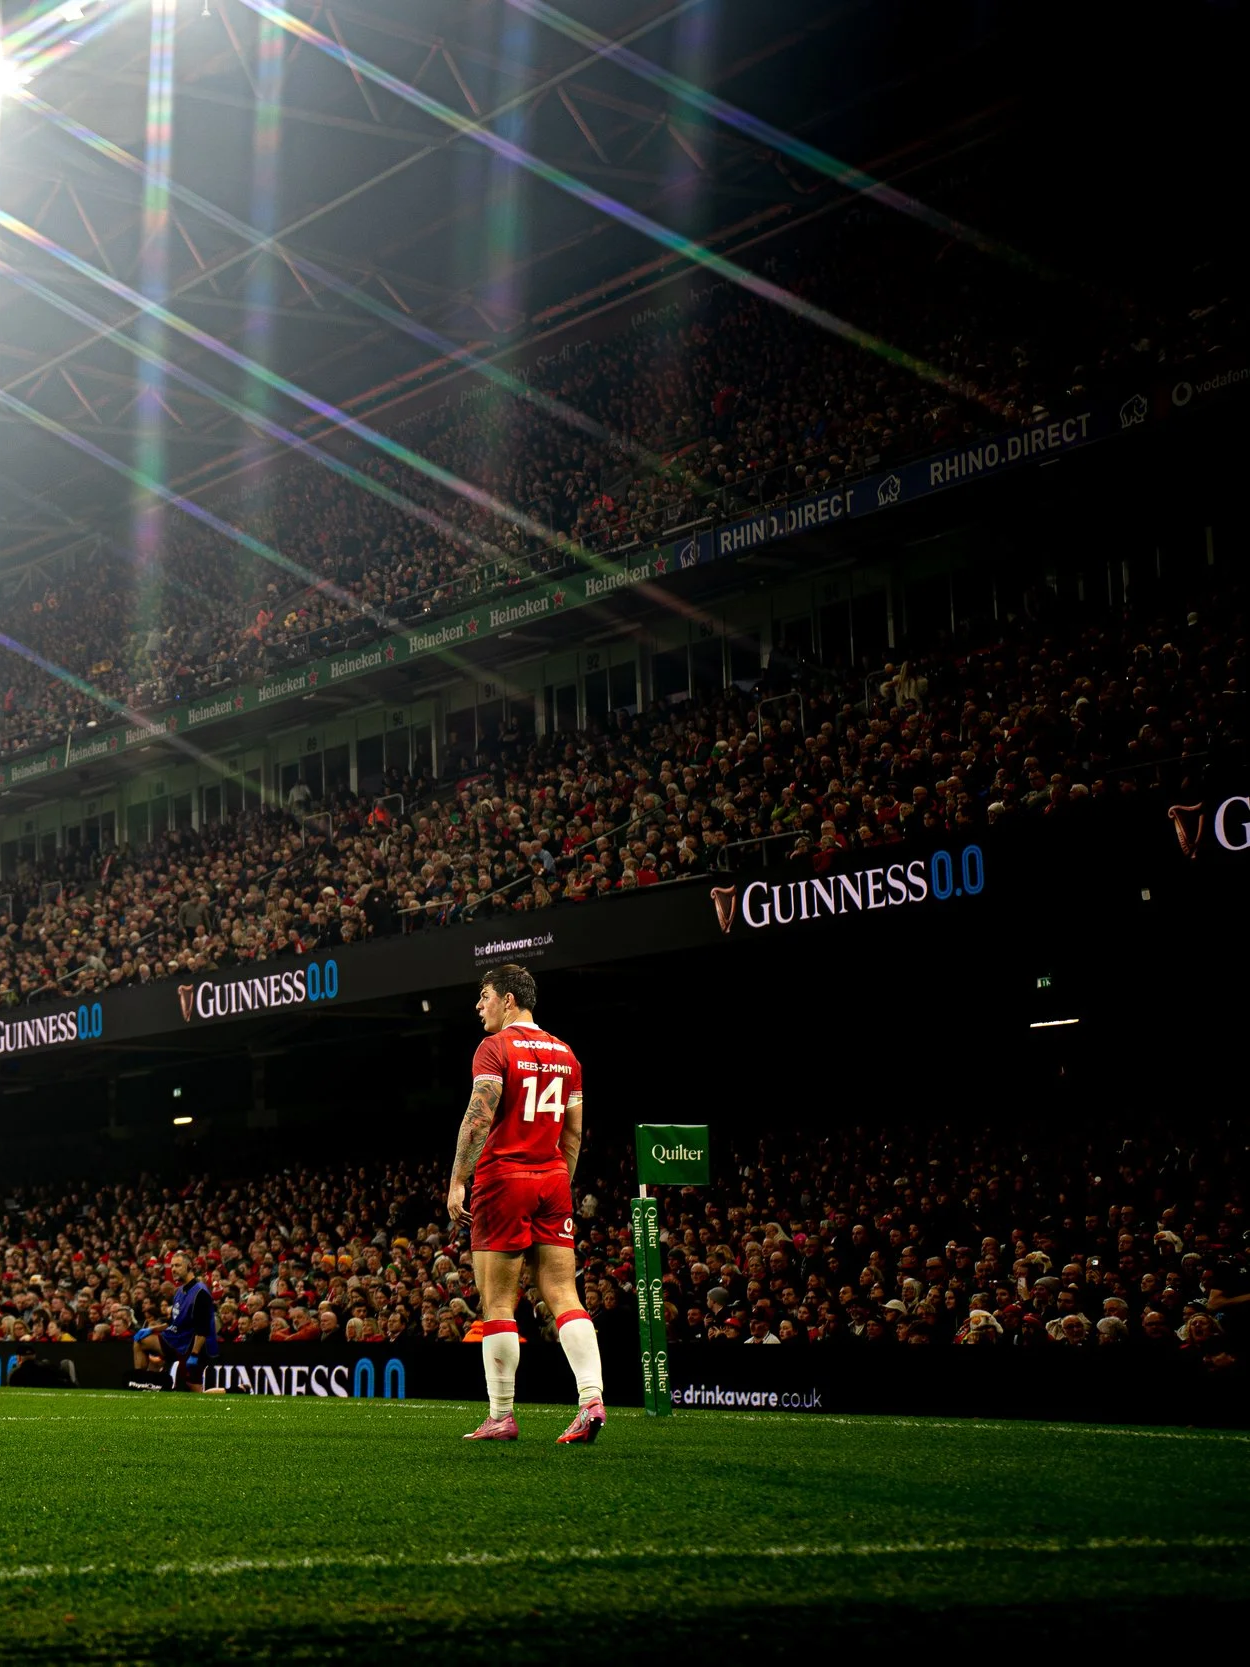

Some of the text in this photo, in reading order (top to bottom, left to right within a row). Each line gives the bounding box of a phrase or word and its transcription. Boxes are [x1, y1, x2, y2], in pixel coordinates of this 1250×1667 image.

[1195, 366, 1250, 393] vodafon
[929, 411, 1092, 487] RHINO.DIRECT
[719, 489, 855, 555] RHINO.DIRECT
[585, 563, 650, 598] Heineken
[489, 597, 550, 628] Heineken
[408, 625, 464, 654] Heineken
[330, 649, 382, 678] Heineken
[586, 652, 600, 671] 92
[258, 675, 306, 702] Heineken
[485, 683, 497, 698] 91
[188, 699, 232, 725] Heineken
[125, 720, 166, 745] Heineken
[742, 844, 984, 929] GUINNESS 0.0
[474, 931, 554, 957] bedrinkaware.co.uk
[196, 959, 338, 1019] GUINNESS 0.0
[77, 1002, 103, 1040] 0.0
[517, 1060, 573, 1075] REES-ZMMIT
[522, 1076, 566, 1123] 14
[651, 1143, 704, 1165] Quilter
[632, 1206, 642, 1251] Quilter
[644, 1205, 659, 1250] Quilter
[636, 1278, 647, 1322] Quilter
[649, 1277, 662, 1322] Quilter
[640, 1350, 652, 1395] Quilter
[654, 1349, 667, 1394] Quilter
[670, 1384, 823, 1408] edrinkaware.co.uk
